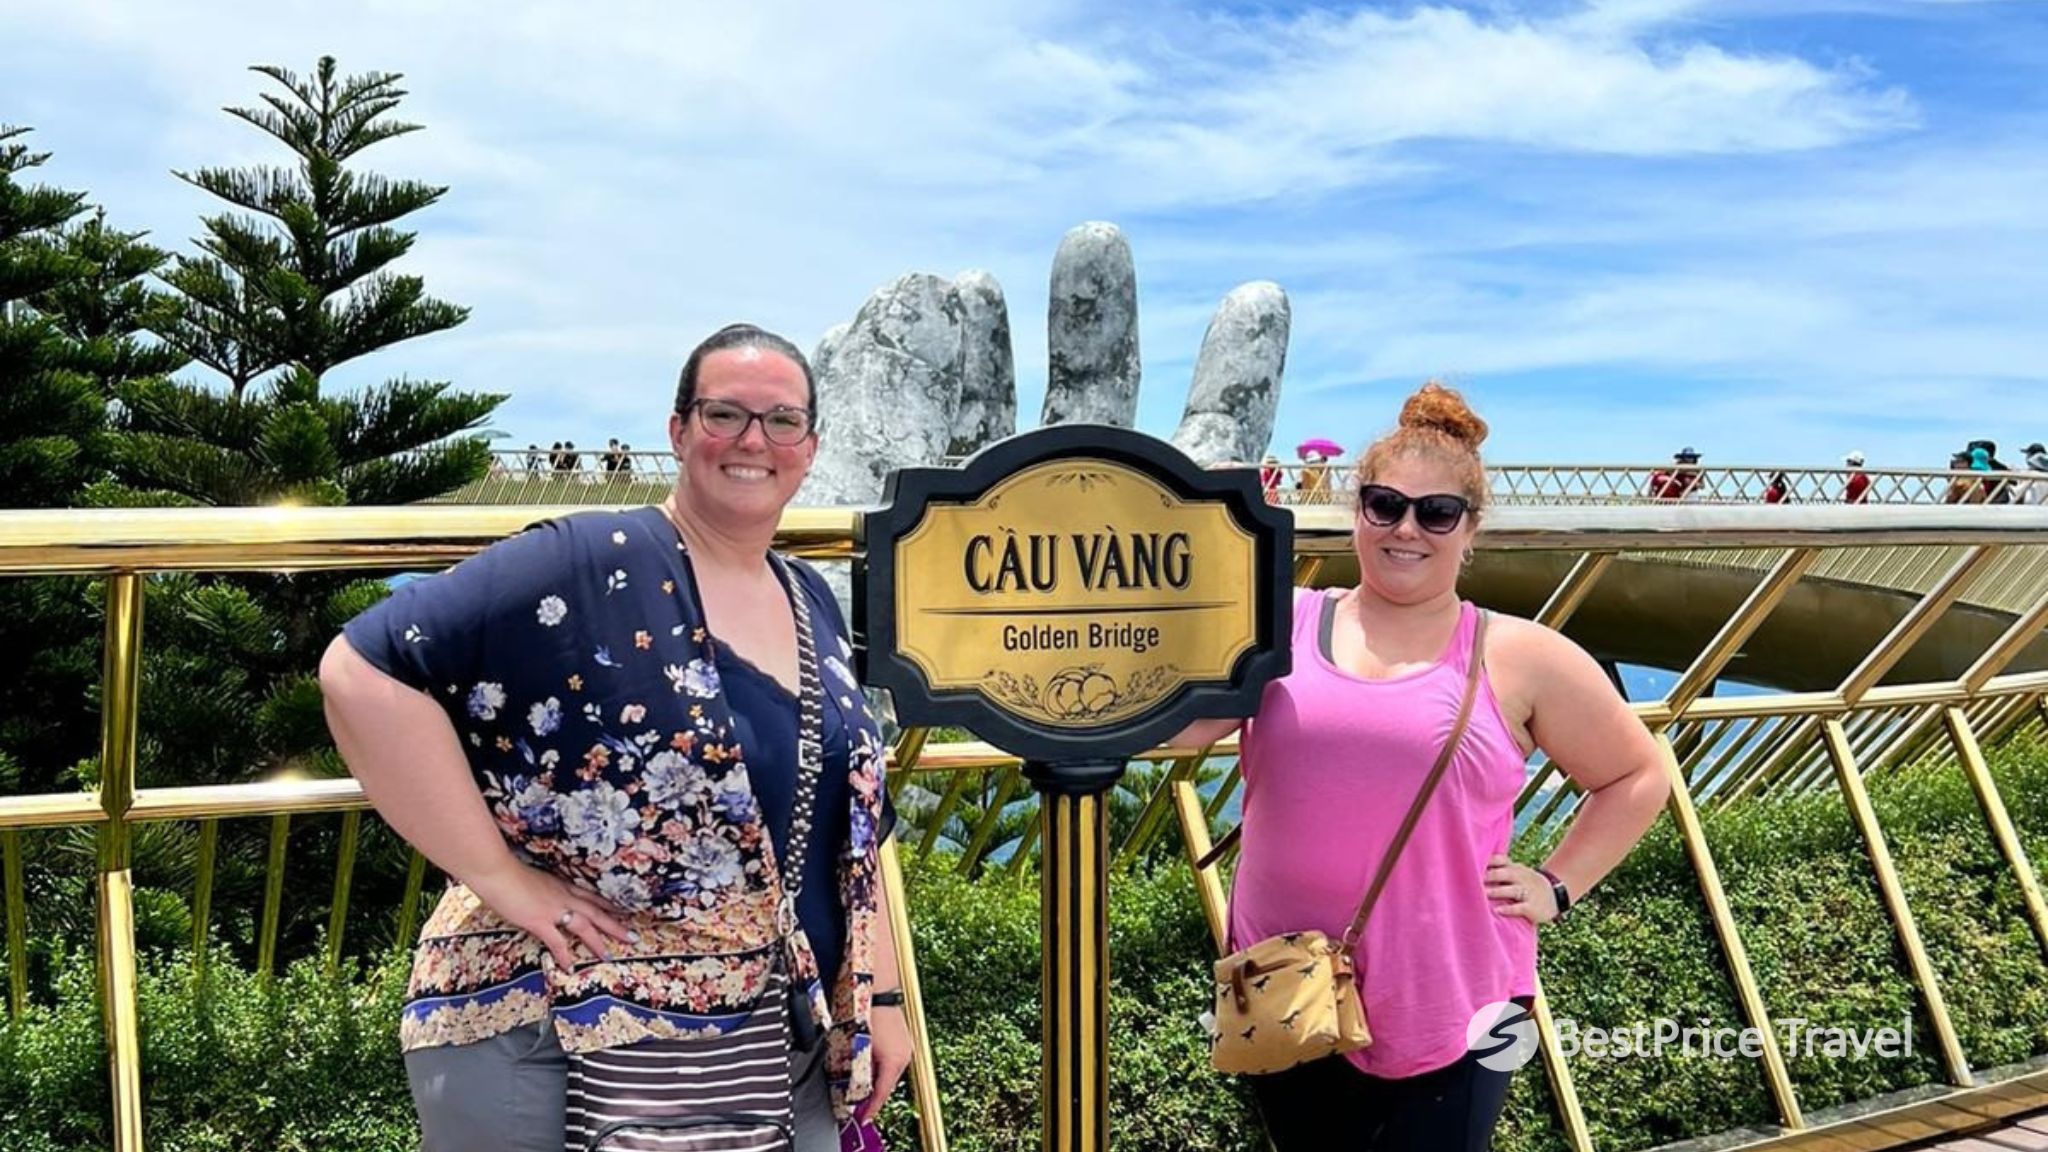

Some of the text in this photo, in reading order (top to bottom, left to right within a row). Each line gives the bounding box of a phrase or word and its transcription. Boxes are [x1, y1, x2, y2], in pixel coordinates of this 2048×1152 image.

[963, 525, 1193, 593] CẦU VÀNG
[1003, 622, 1160, 654] Golden Bridge
